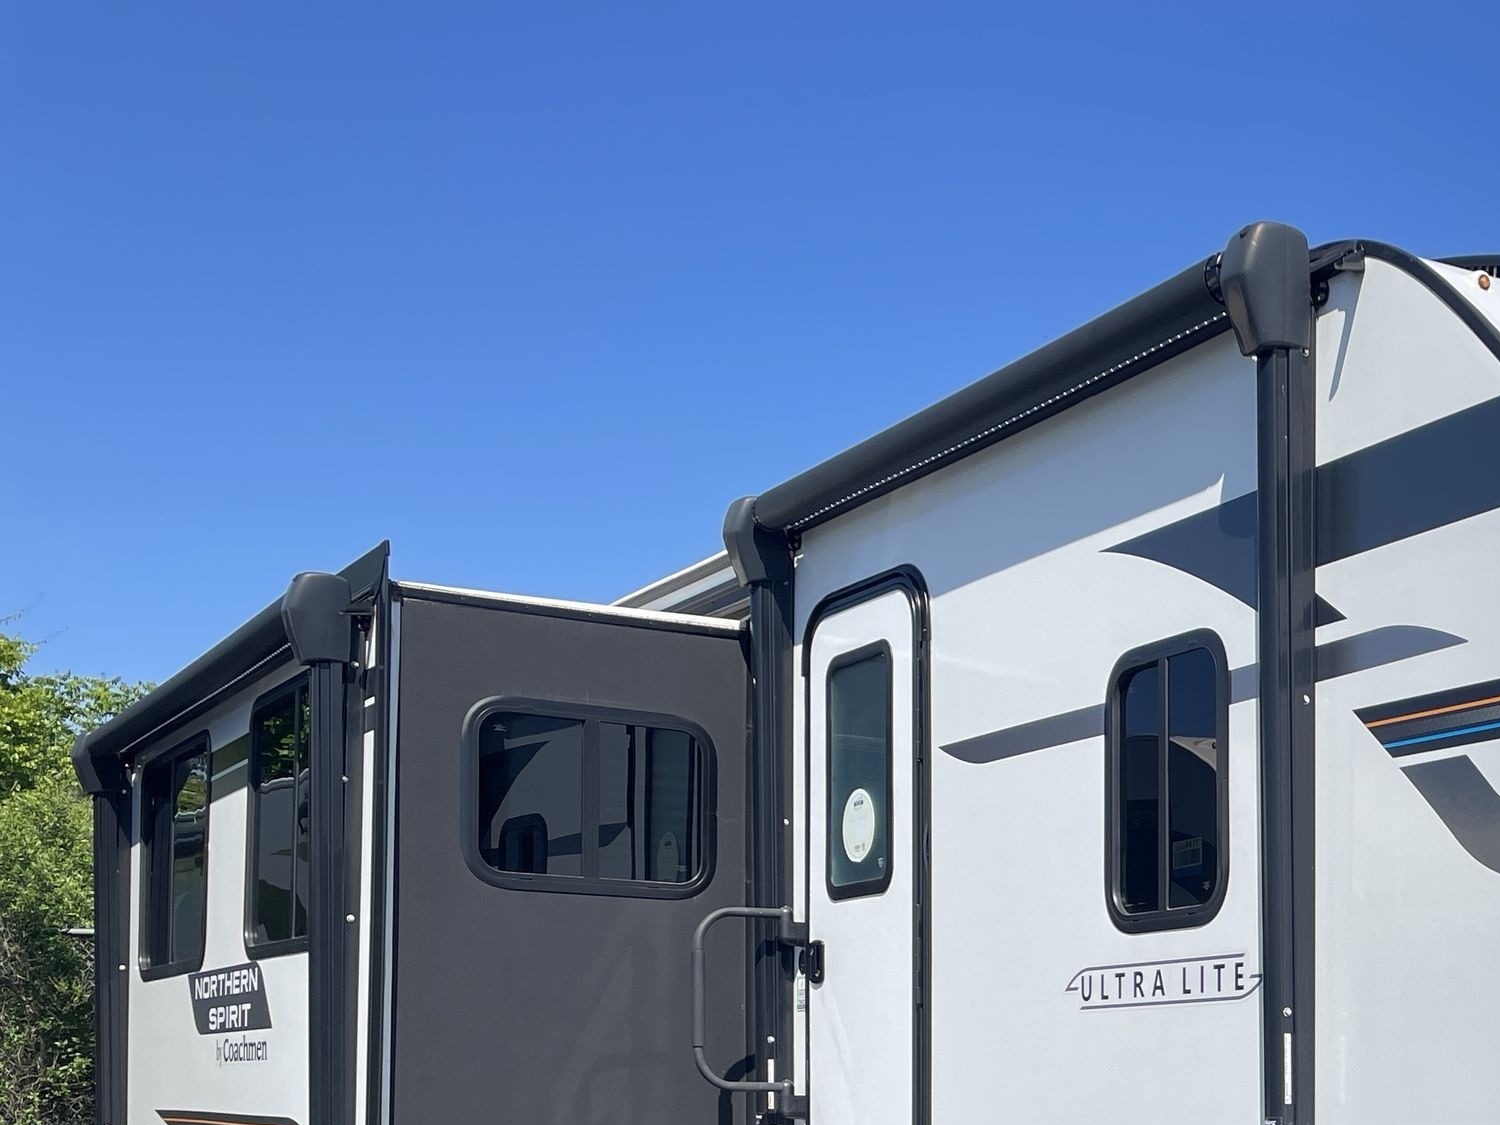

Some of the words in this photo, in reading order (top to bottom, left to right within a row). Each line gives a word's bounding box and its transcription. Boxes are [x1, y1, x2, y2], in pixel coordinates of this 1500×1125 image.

[195, 967, 258, 1000] NORTHERN
[1081, 969, 1165, 1001] ULTRA
[1182, 962, 1244, 996] LITE
[208, 1003, 251, 1031] SPIRIT
[223, 1034, 268, 1063] Coachmen
